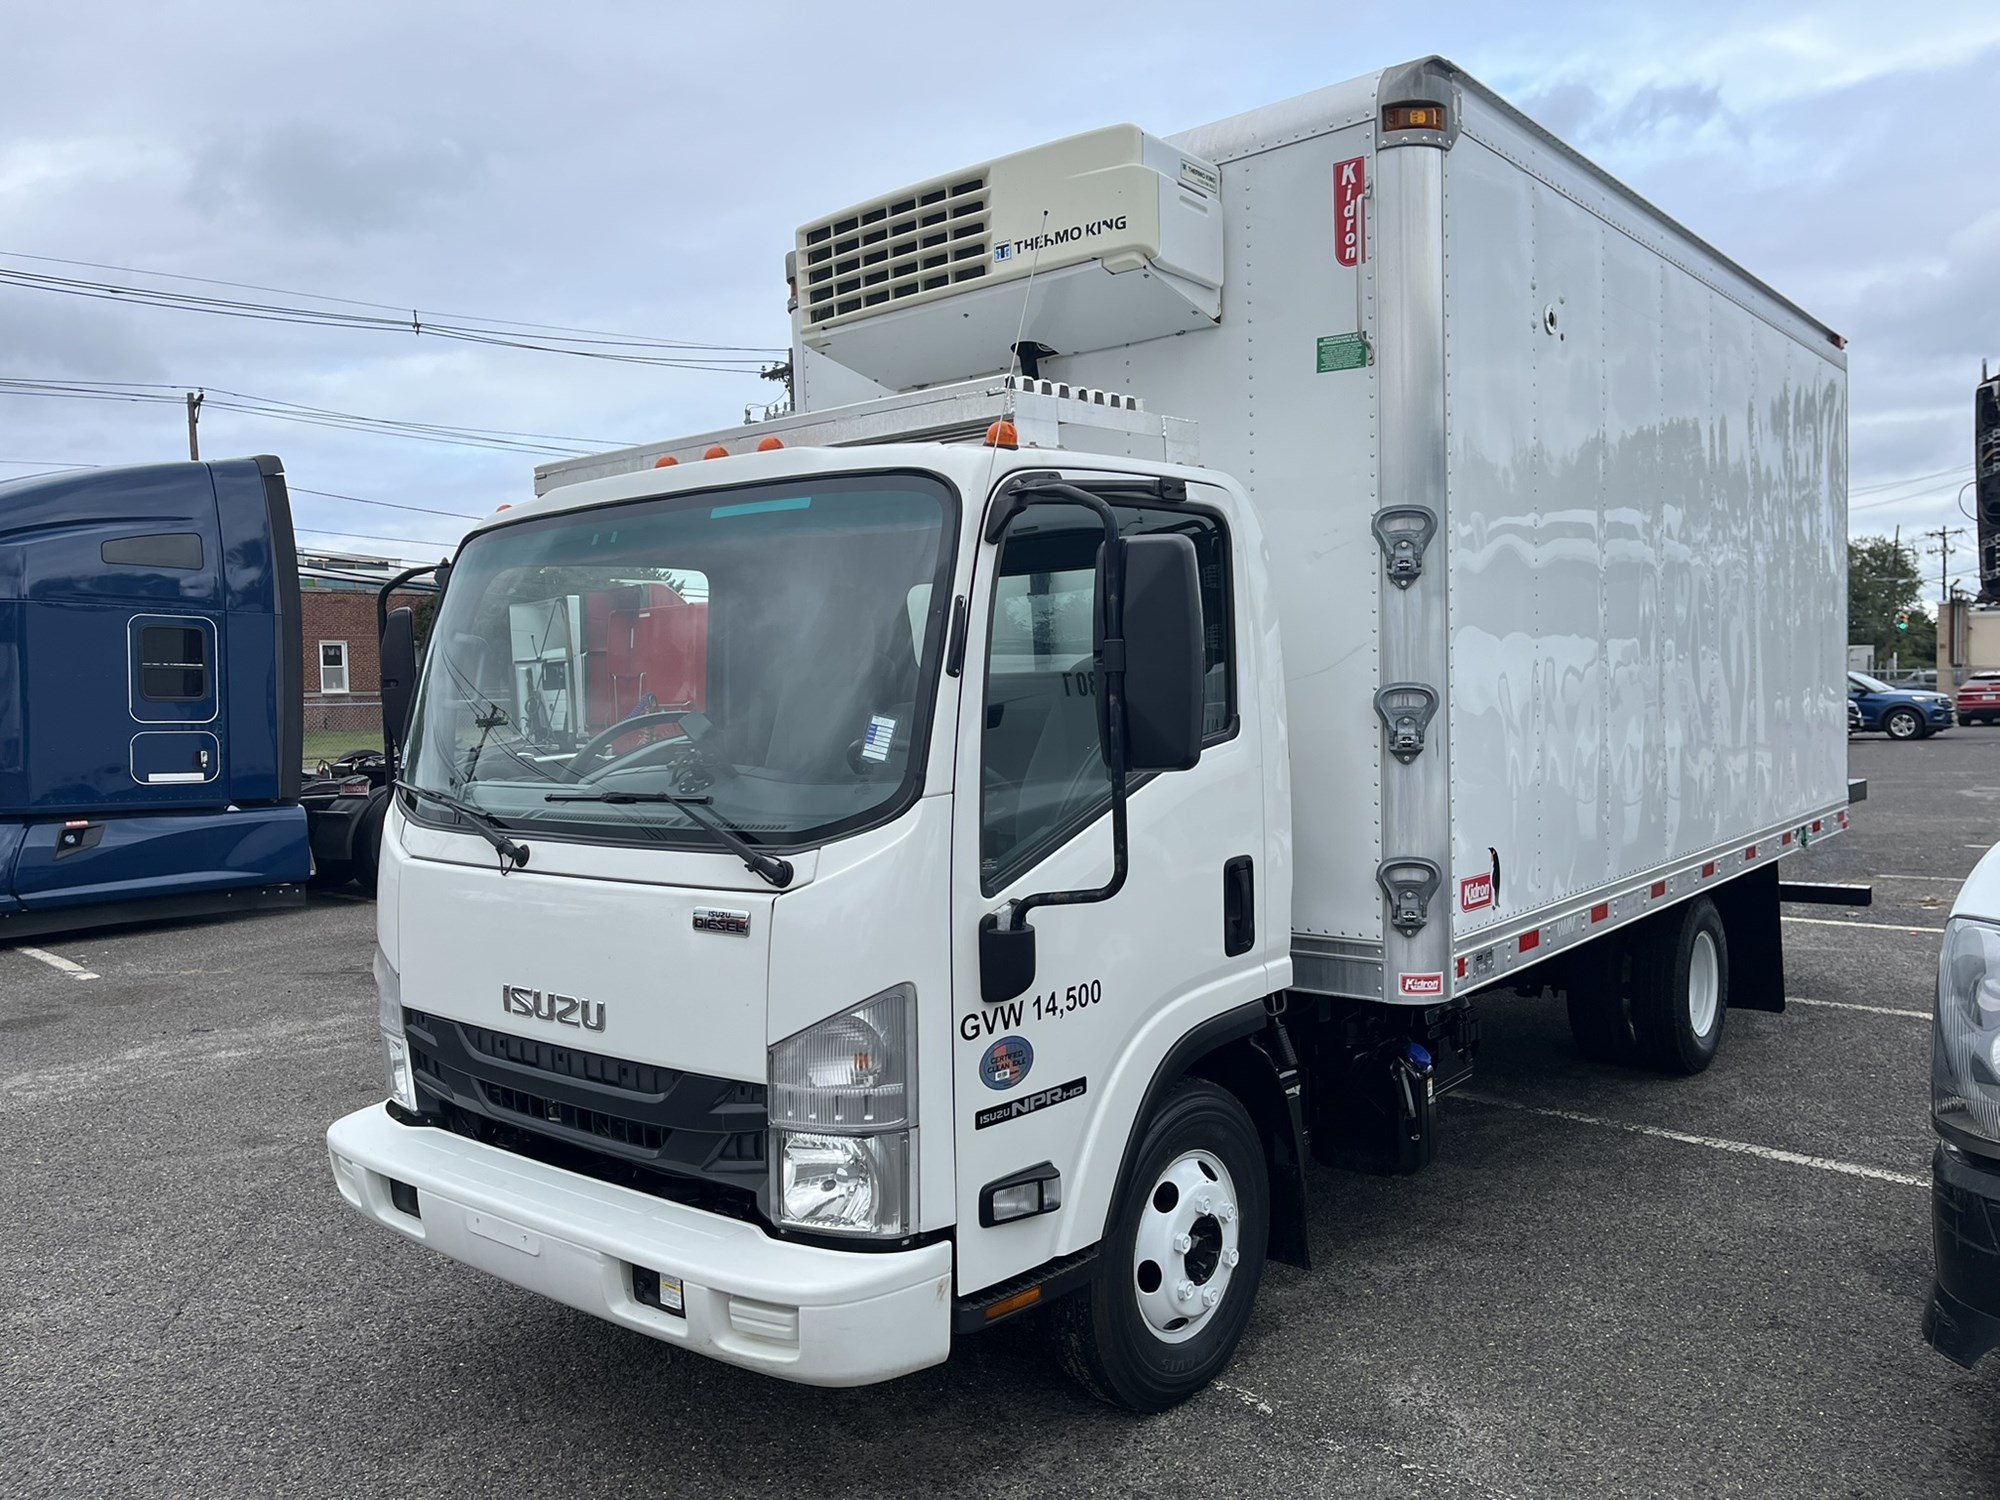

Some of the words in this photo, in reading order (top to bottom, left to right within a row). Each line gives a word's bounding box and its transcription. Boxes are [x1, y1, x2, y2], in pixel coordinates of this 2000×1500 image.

[1341, 162, 1358, 260] Kidron
[1085, 215, 1127, 237] KING
[1463, 882, 1490, 906] Kidron
[694, 917, 745, 933] DIESEL
[1405, 979, 1439, 991] Kidron
[503, 983, 606, 1033] ISUZU
[960, 1000, 1024, 1041] GVW
[1033, 979, 1102, 1021] 14,500
[987, 1062, 1010, 1073] CLEAN
[1013, 1057, 1026, 1067] IDLE
[991, 1050, 1024, 1065] CERTIFIED
[980, 1107, 1010, 1124] ISUZU
